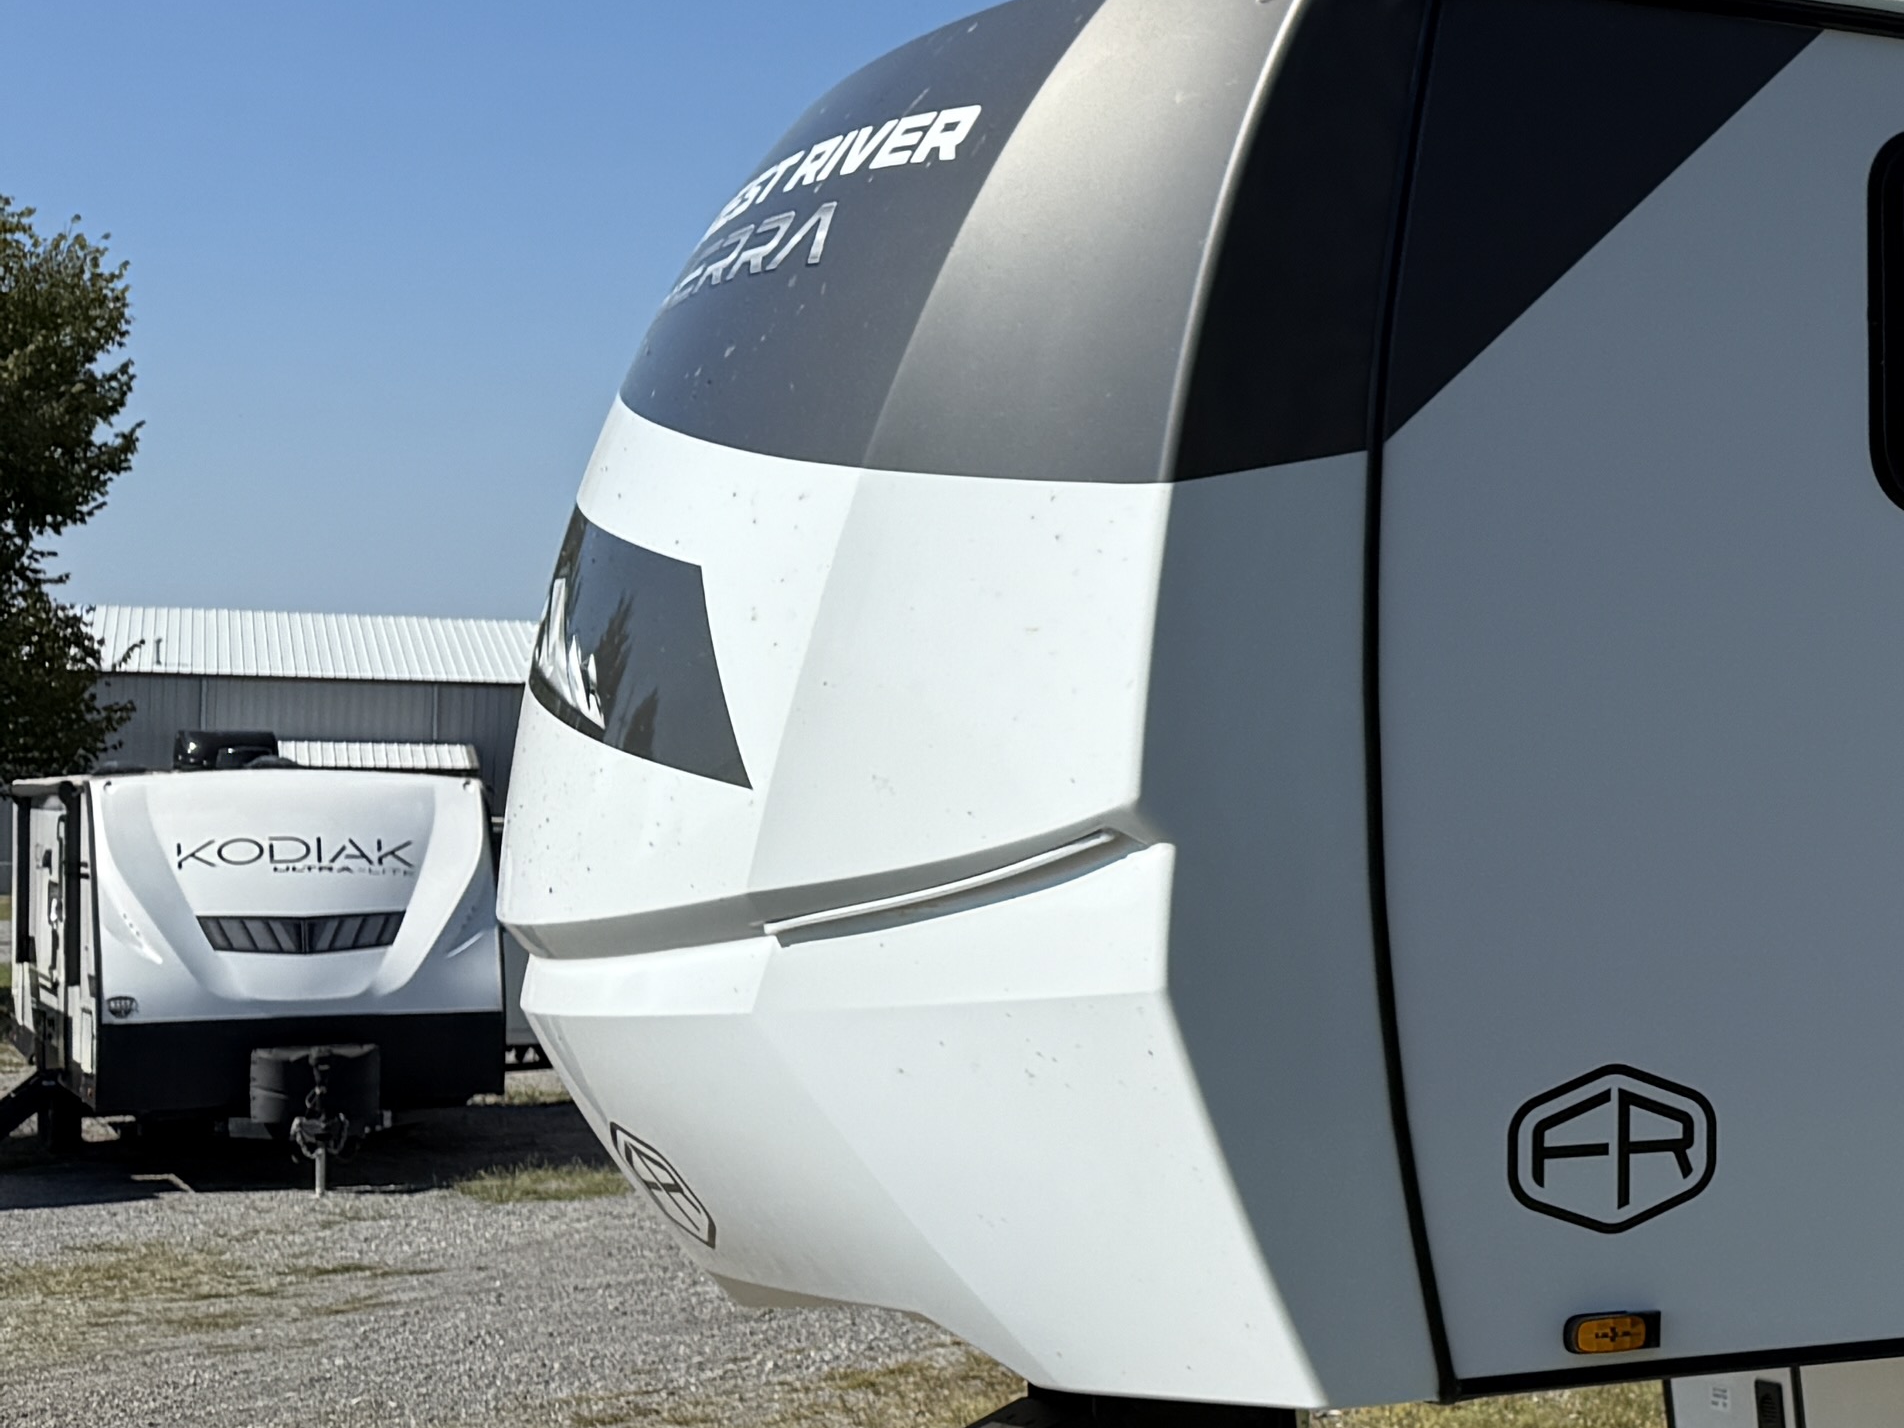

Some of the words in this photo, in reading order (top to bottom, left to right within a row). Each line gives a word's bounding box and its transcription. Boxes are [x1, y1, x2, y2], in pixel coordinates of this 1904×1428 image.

[782, 104, 982, 193] RIVER
[176, 835, 414, 871] KODIAK
[1531, 1086, 1694, 1210] FR
